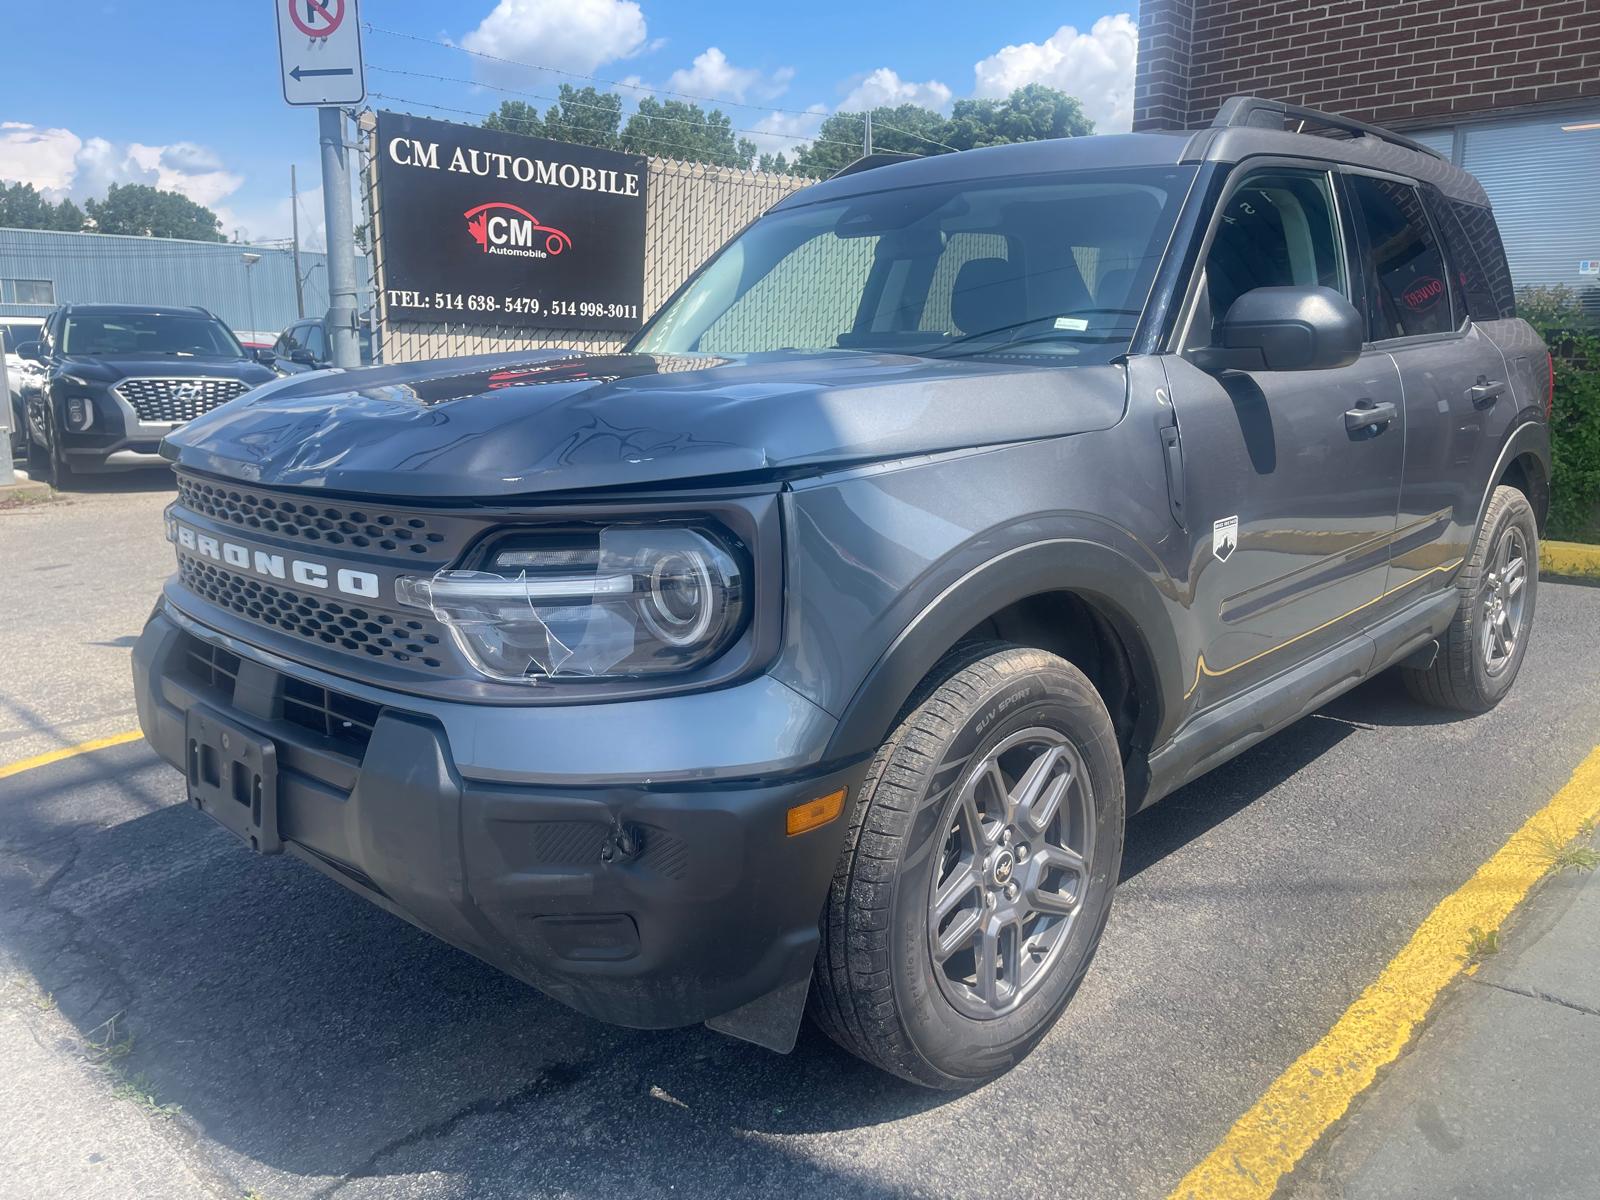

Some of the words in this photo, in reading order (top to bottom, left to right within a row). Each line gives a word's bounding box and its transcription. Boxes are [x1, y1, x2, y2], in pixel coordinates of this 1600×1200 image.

[389, 137, 440, 170] CM
[447, 146, 639, 197] AUTOMOBILE
[487, 216, 532, 247] CM
[488, 245, 547, 259] Automobile
[387, 290, 430, 308] TEL:
[434, 293, 464, 310] 514
[467, 294, 501, 312] 638-
[504, 297, 540, 314] 5479
[551, 300, 577, 316] 514
[579, 302, 638, 319] 998-3011
[178, 525, 379, 599] BRONCO
[975, 708, 996, 735] SUV
[998, 687, 1031, 712] SPORT
